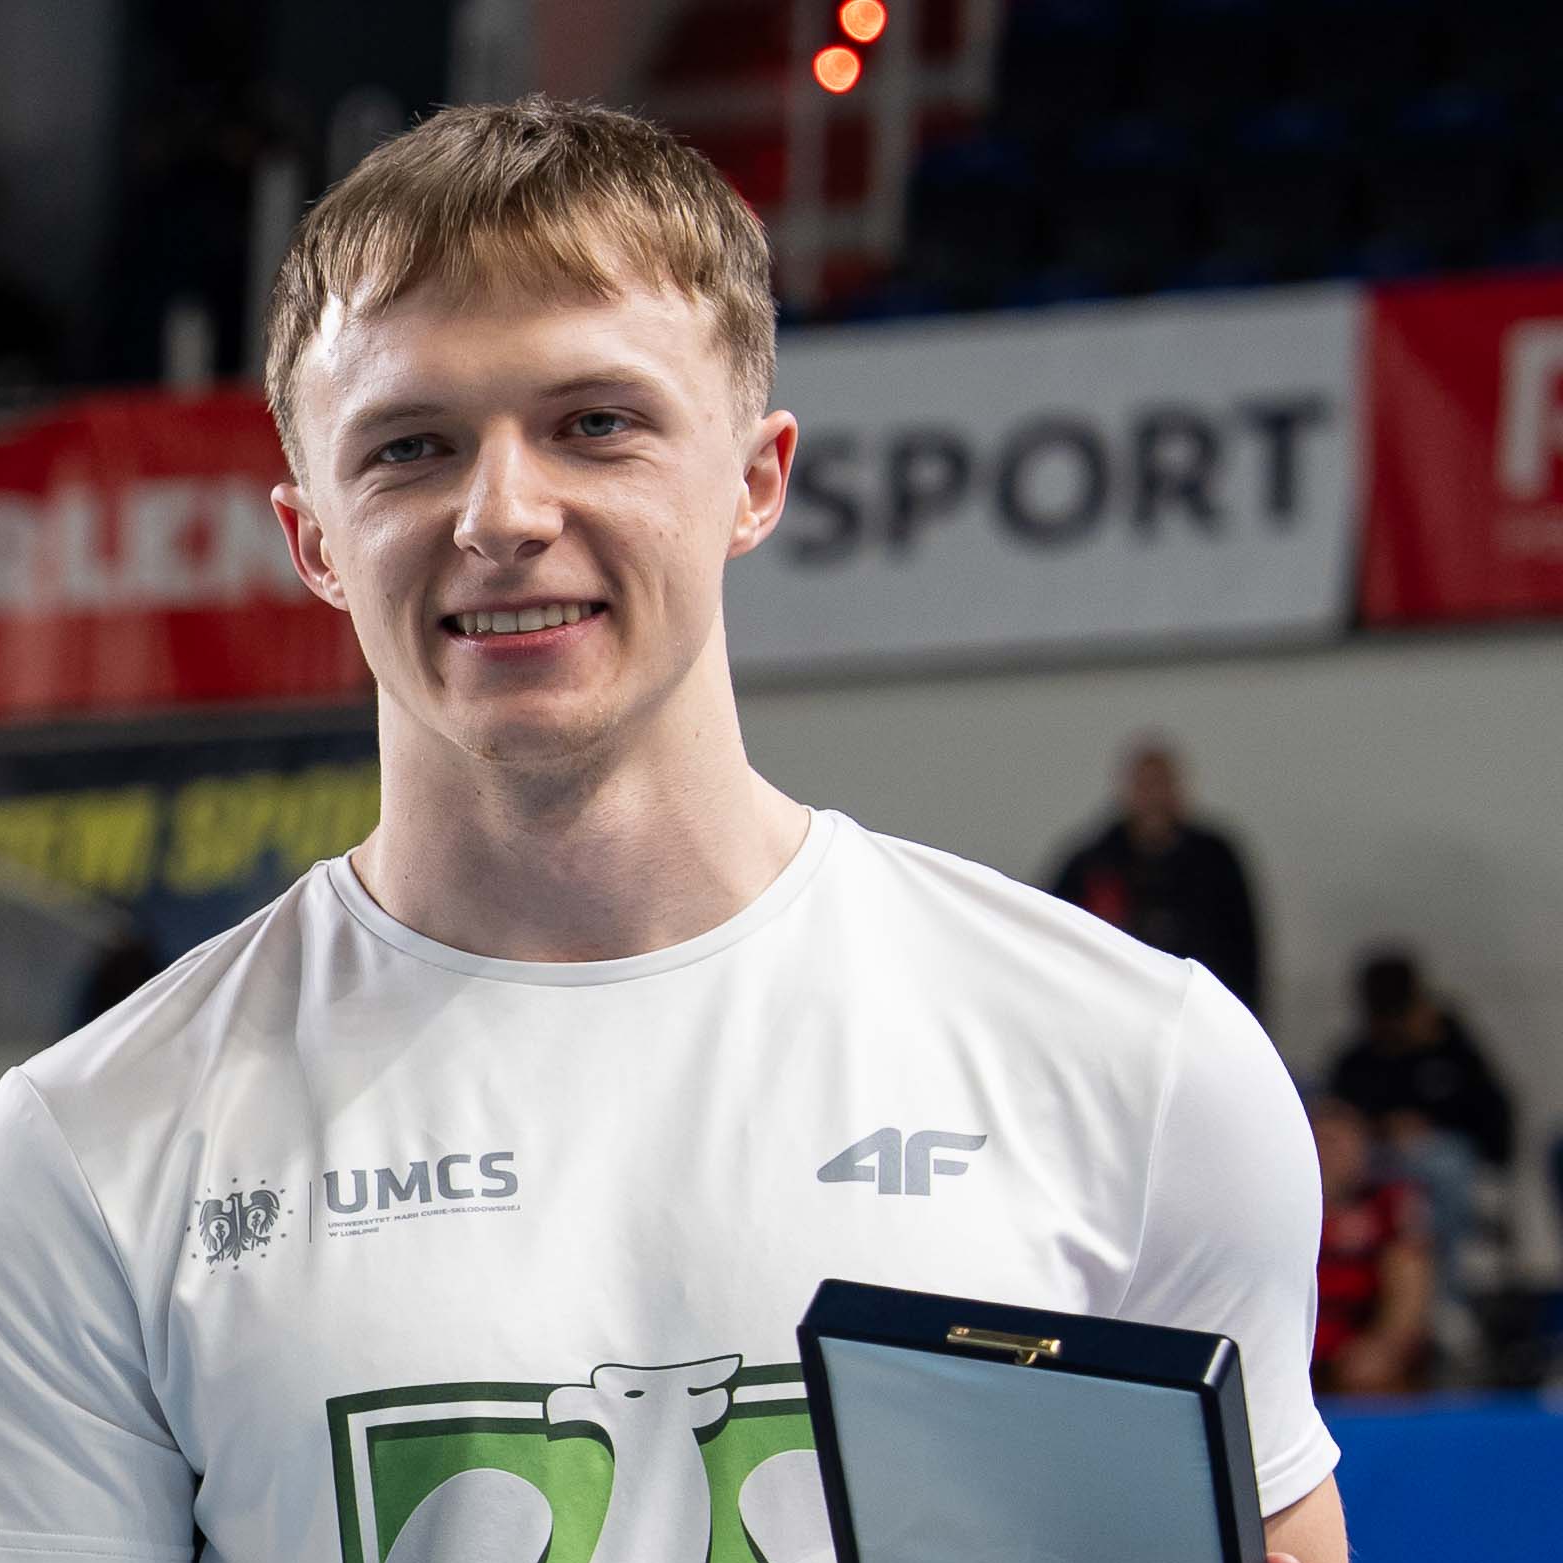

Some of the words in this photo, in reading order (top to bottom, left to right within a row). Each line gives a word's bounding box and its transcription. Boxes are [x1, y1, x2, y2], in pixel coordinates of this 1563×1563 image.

[786, 396, 1331, 568] SPORT
[323, 1152, 518, 1214] UMCS
[817, 1127, 987, 1196] 4F
